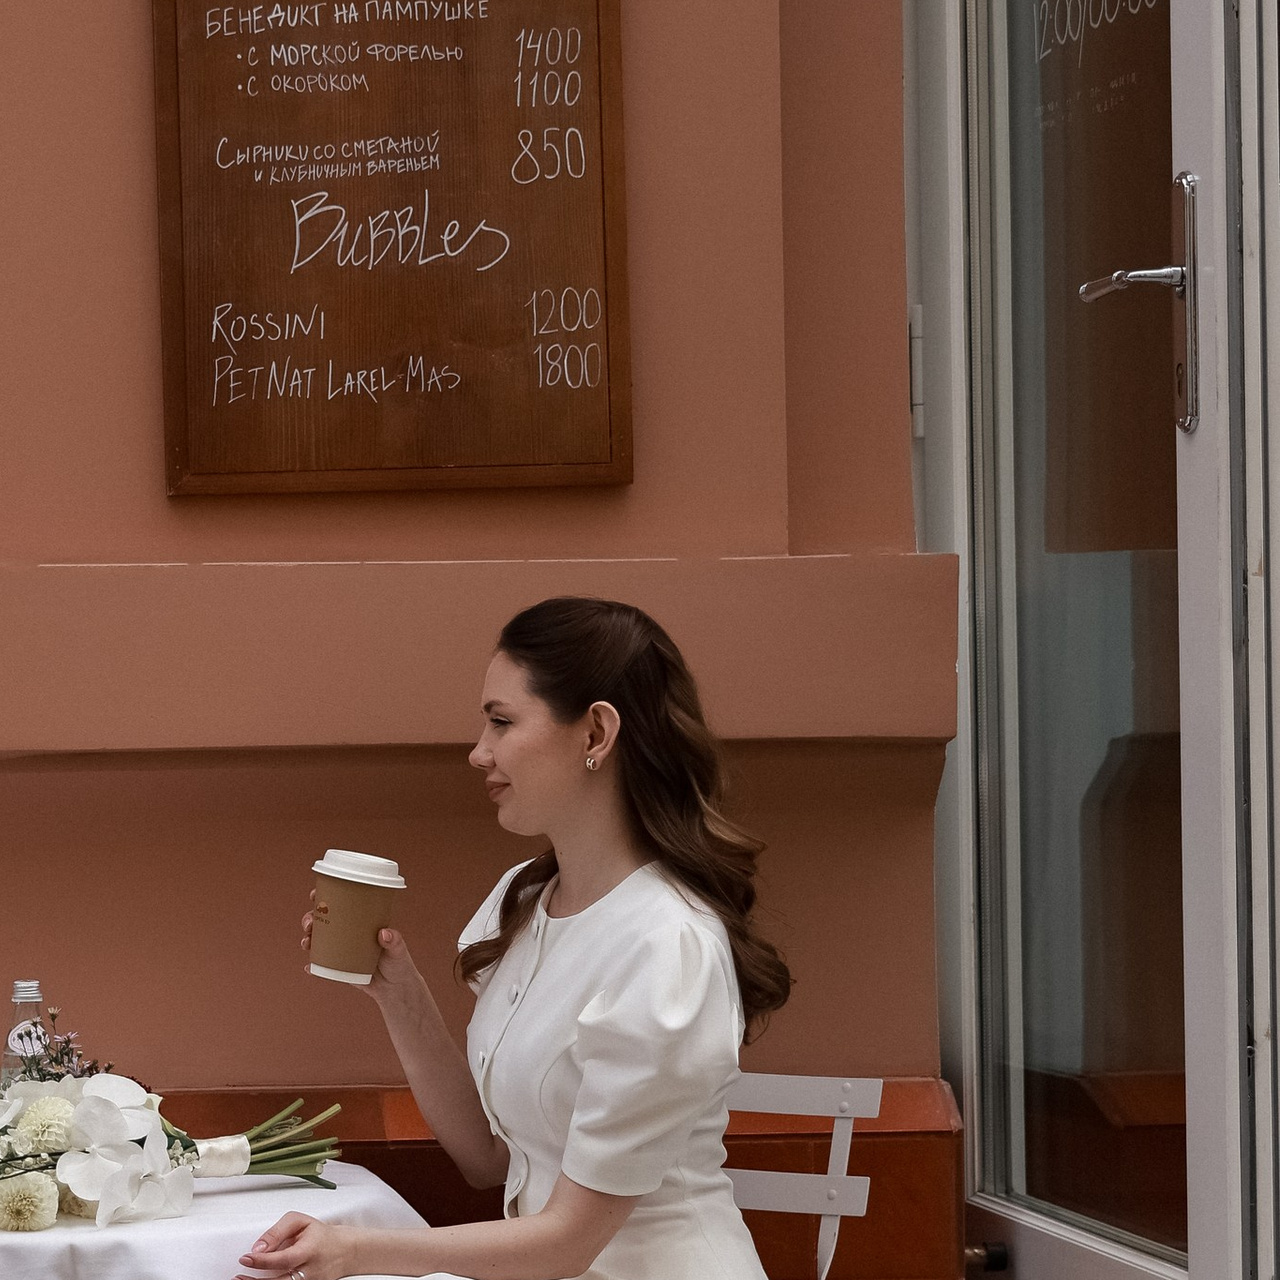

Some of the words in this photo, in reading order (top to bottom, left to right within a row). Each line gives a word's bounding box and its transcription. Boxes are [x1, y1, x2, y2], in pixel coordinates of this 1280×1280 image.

[206, 2, 327, 39] БЕНЕДИКТ
[334, 2, 359, 24] НА
[270, 41, 360, 67] МОРСКОЙ
[366, 43, 463, 63] ФОРЕЛЬЮ
[515, 27, 582, 67] 1400
[271, 73, 369, 93] ОКОРОКОМ
[514, 70, 582, 107] 1100
[270, 162, 362, 186] КЛУБНИЧНЫМ
[366, 154, 440, 176] ВАРЕНЬЕМ
[313, 144, 336, 160] СО
[341, 129, 440, 158] СМЕТАНОЙ
[511, 127, 586, 184] 850
[212, 303, 324, 355] ROSSINI
[524, 286, 602, 337] 1200
[533, 342, 602, 389] 1800
